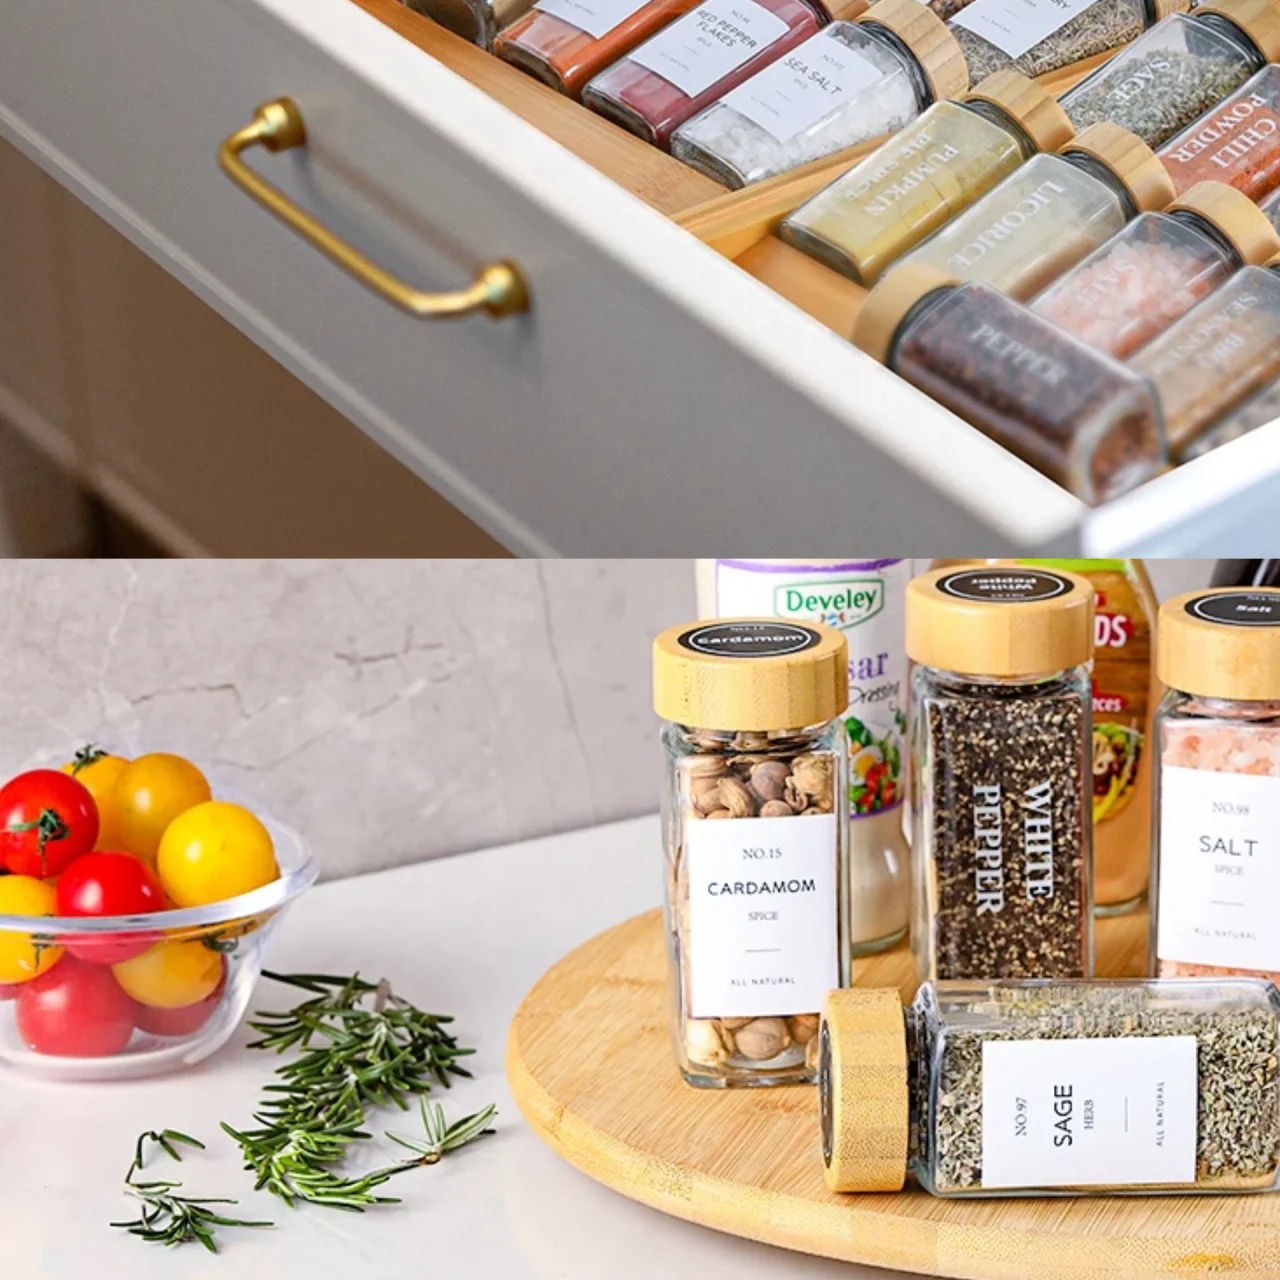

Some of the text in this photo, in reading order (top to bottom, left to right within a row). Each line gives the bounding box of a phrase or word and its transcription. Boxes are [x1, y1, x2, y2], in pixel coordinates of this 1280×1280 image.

[695, 20, 738, 48] FLAKES
[696, 8, 717, 24] RED
[716, 19, 759, 50] PEPPER
[783, 56, 808, 75] SEA
[808, 69, 843, 97] SALT
[1107, 58, 1172, 106] SAGE
[1168, 92, 1268, 163] POWDER
[1209, 117, 1278, 169] CHILI
[863, 142, 960, 217] PUMPKIN
[946, 179, 1066, 268] LICORICE
[970, 322, 1068, 387] PEPPER
[785, 588, 877, 613] Develey
[697, 634, 803, 645] Cardamom
[742, 847, 782, 860] NO.15
[972, 783, 1005, 917] PEPPER
[1023, 779, 1054, 901] WHITE
[1198, 835, 1259, 857] SALT
[707, 879, 816, 896] CARDAMOM
[1214, 864, 1245, 876] SPICE
[748, 911, 779, 922] SPICE
[730, 977, 796, 987] ALL NATURAL
[1014, 1096, 1028, 1137] NO.97
[1053, 1083, 1074, 1148] SAGE
[1083, 1098, 1094, 1131] HERB
[1155, 1080, 1166, 1147] ALL NATURAL
